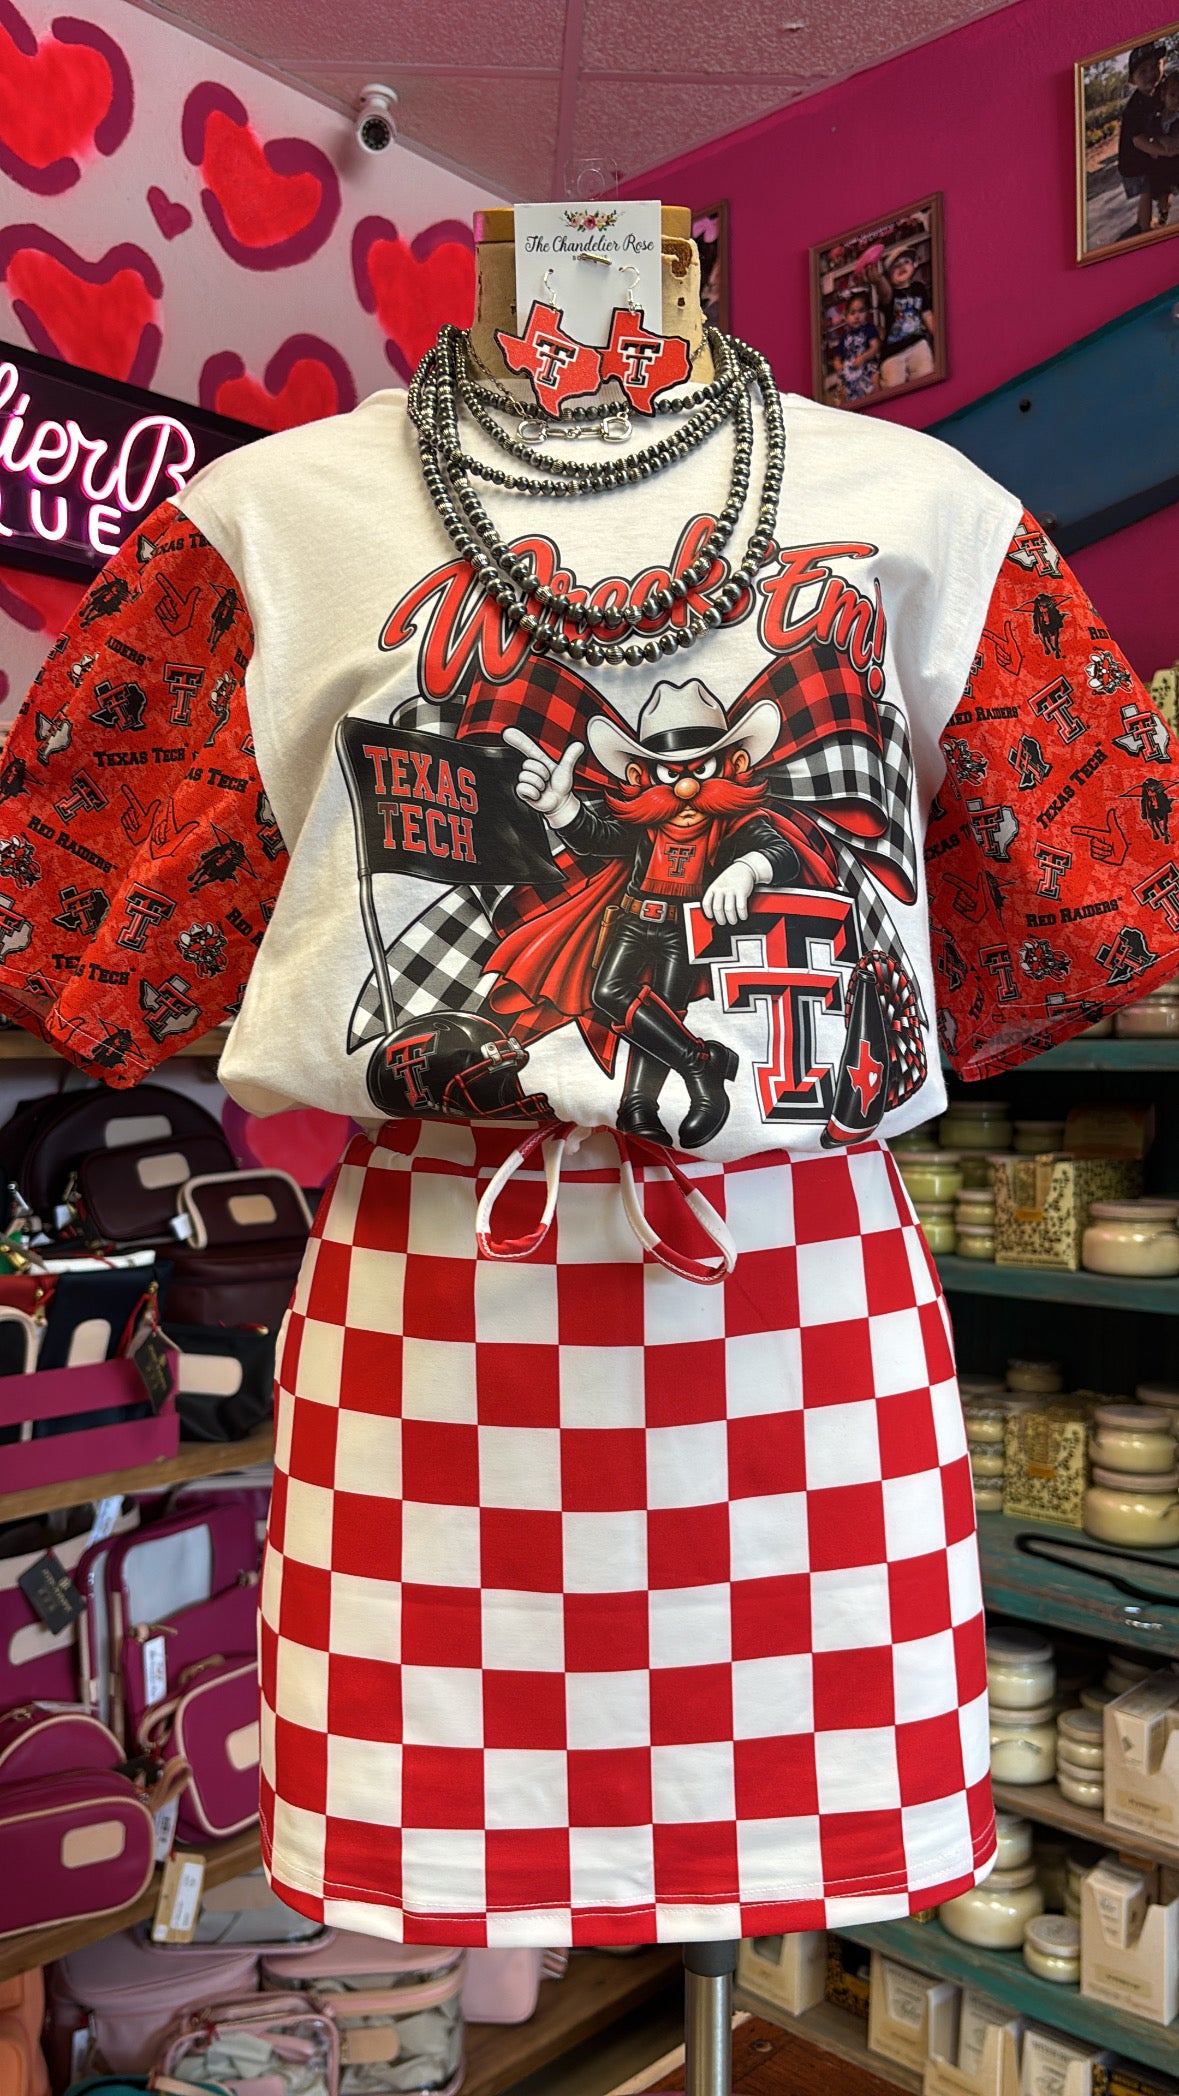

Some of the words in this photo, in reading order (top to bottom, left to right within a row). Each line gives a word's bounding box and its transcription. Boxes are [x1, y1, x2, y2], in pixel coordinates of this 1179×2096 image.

[525, 235, 550, 253] The
[552, 234, 621, 253] Chandelier
[622, 233, 655, 254] Rose
[0, 486, 123, 556] UE
[93, 751, 148, 768] TEXAS
[151, 747, 185, 764] TECH
[207, 767, 249, 794] TECH
[362, 744, 479, 815] TEXAS
[1036, 785, 1075, 829] TEXAS
[1069, 749, 1108, 786] TECH
[27, 815, 54, 840] RED
[56, 829, 112, 874] RAIDERS
[377, 801, 477, 864] TECH
[1026, 913, 1056, 928] RED
[1060, 901, 1119, 924] RAIDERS
[88, 963, 130, 985] TECH
